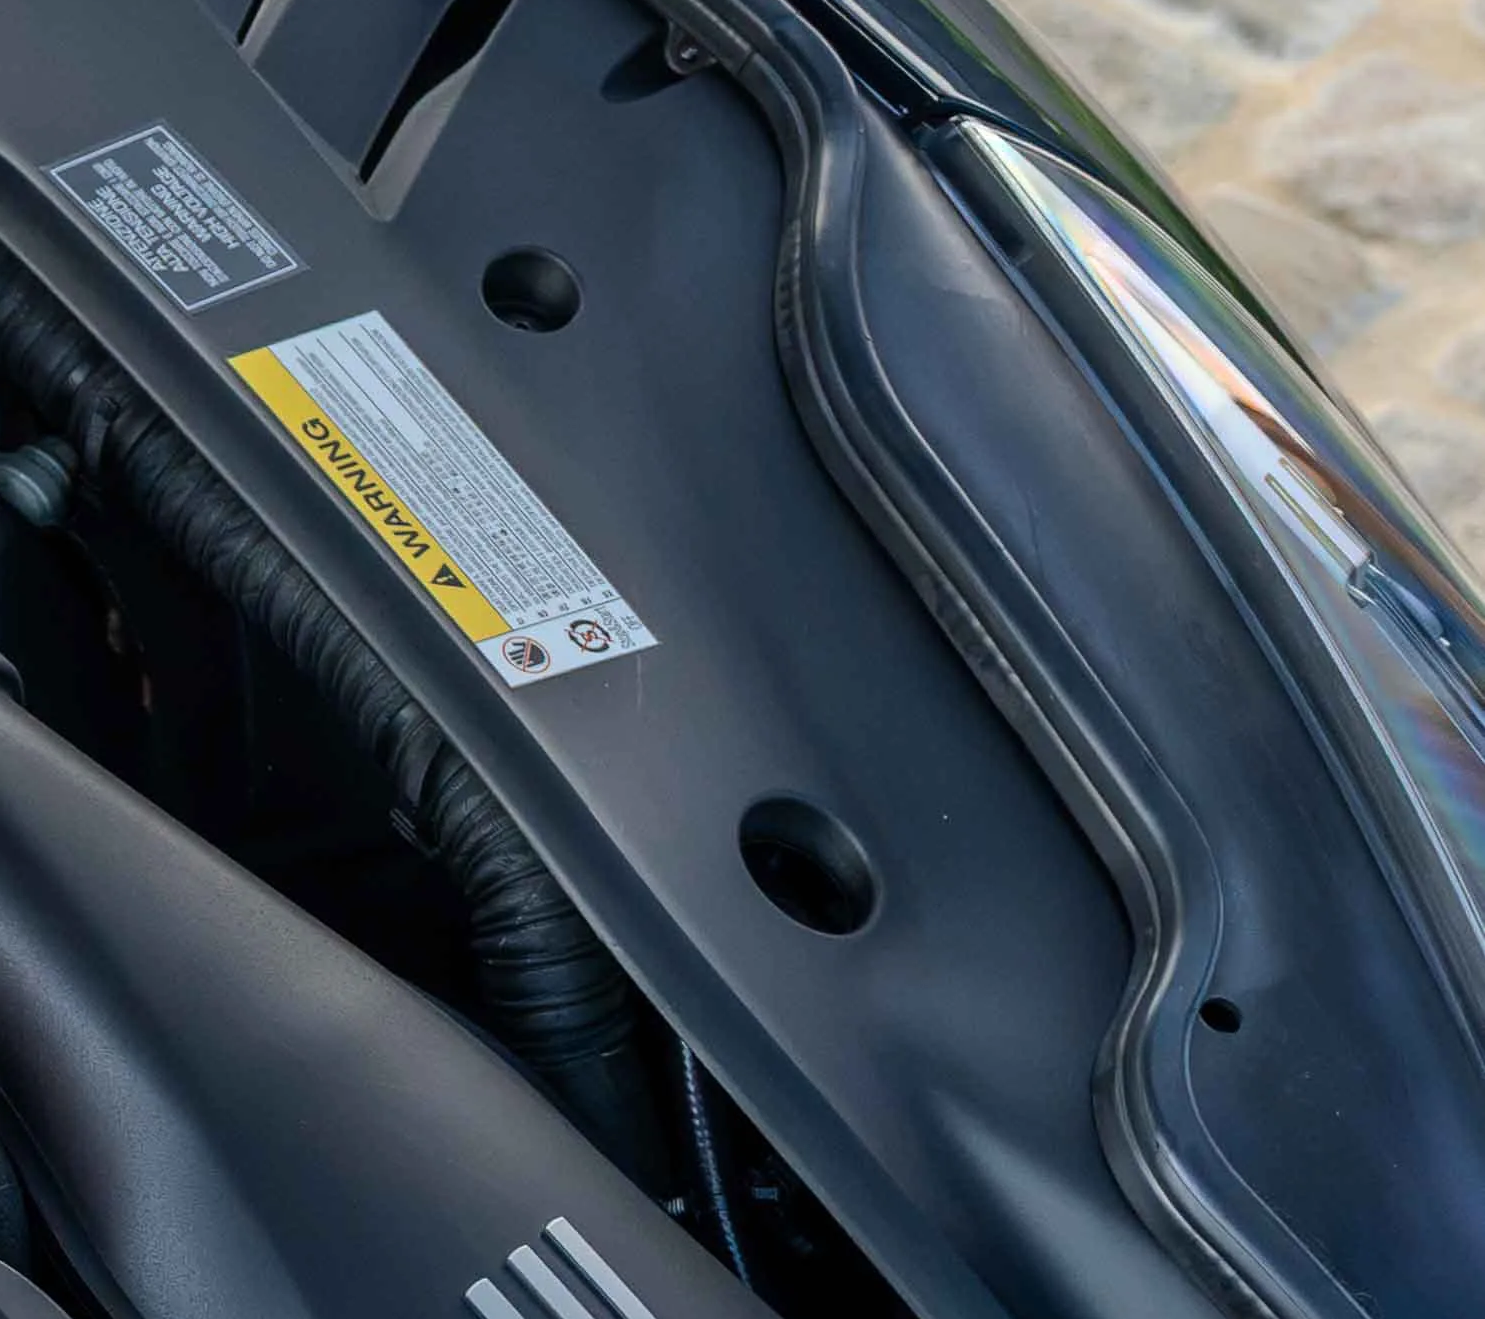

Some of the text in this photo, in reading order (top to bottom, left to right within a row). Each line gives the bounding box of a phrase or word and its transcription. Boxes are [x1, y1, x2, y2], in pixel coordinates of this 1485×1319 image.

[95, 185, 158, 245] TENSIONE
[150, 184, 211, 242] WARNING
[152, 165, 206, 217] VOLTAGE
[88, 198, 166, 270] ATTENZIONE
[156, 243, 188, 271] ALTA
[203, 216, 239, 248] HIGH
[302, 418, 429, 557] WARNING
